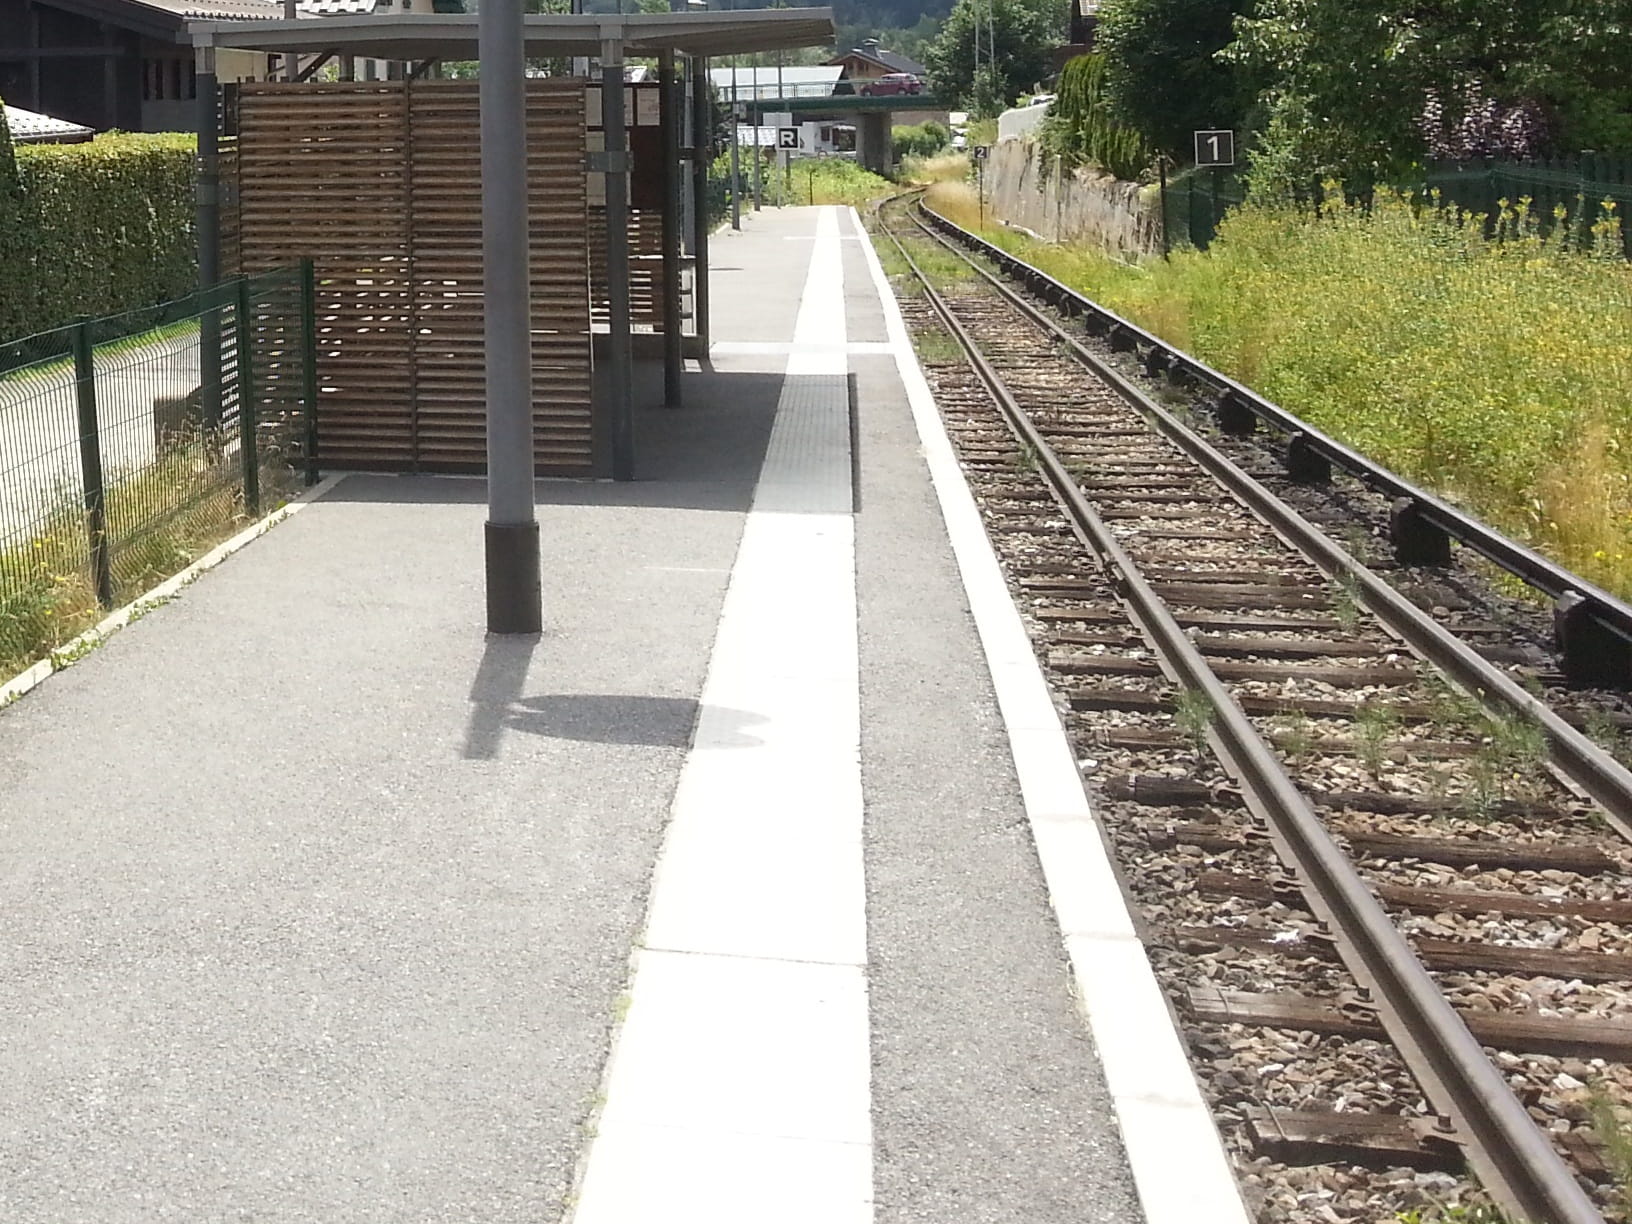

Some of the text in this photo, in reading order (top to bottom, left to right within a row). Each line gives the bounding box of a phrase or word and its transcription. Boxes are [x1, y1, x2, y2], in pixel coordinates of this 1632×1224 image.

[780, 130, 794, 146] R
[977, 147, 984, 158] 2
[1207, 136, 1218, 161] 1
